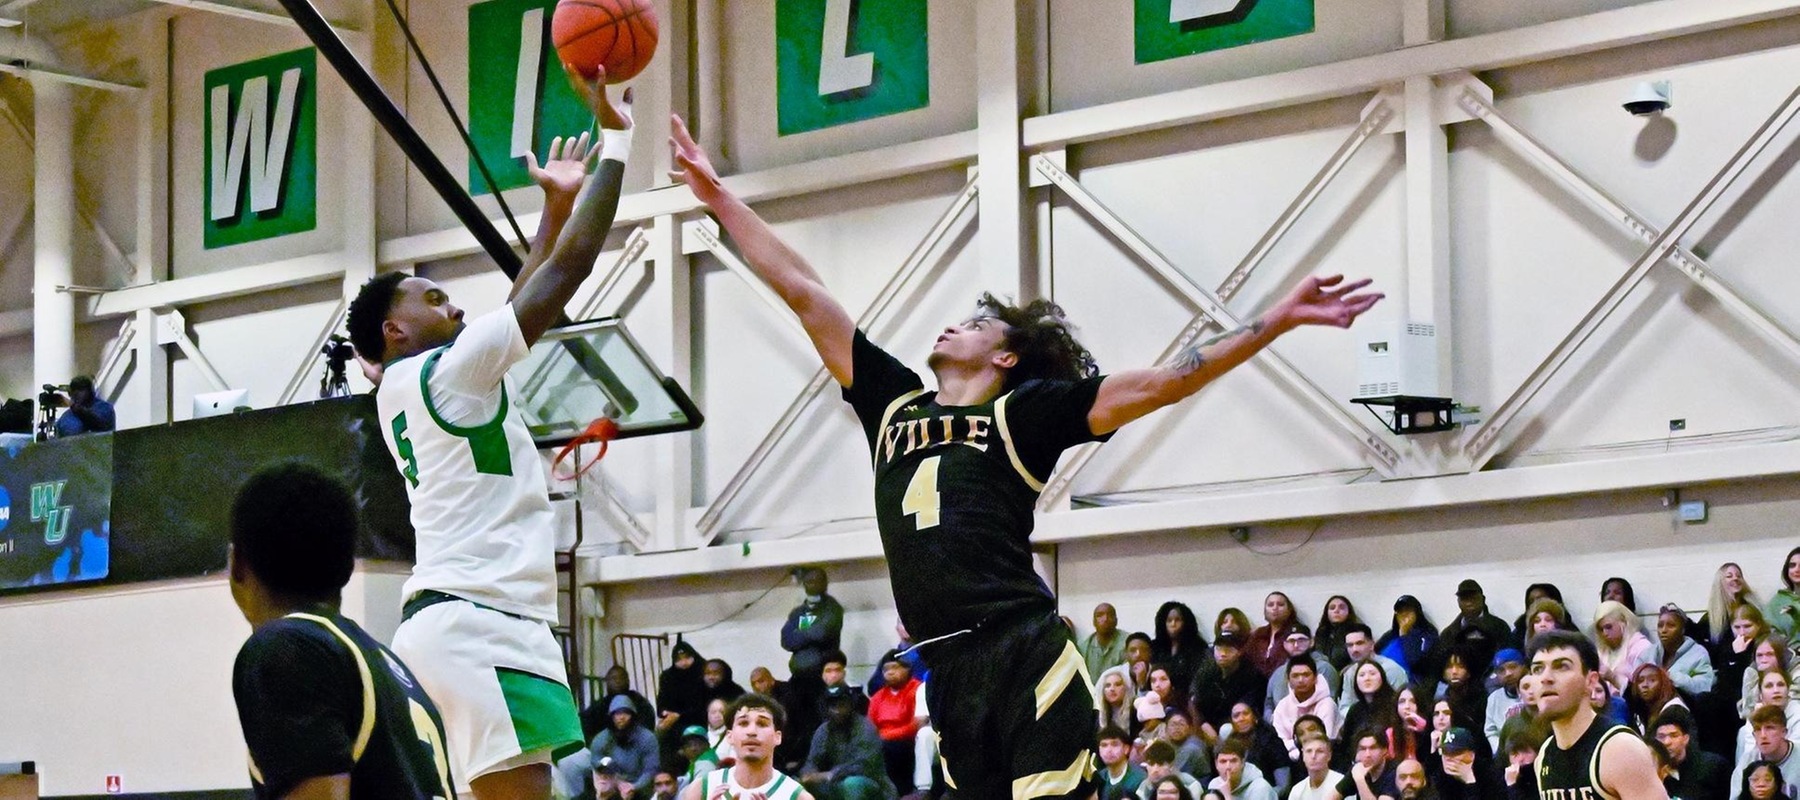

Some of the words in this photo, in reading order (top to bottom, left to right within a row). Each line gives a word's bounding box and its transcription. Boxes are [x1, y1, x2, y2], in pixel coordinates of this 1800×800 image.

[211, 67, 302, 221] W
[510, 7, 544, 159] I
[391, 409, 419, 490] 5
[885, 415, 991, 464] VILLE
[901, 455, 941, 531] 4
